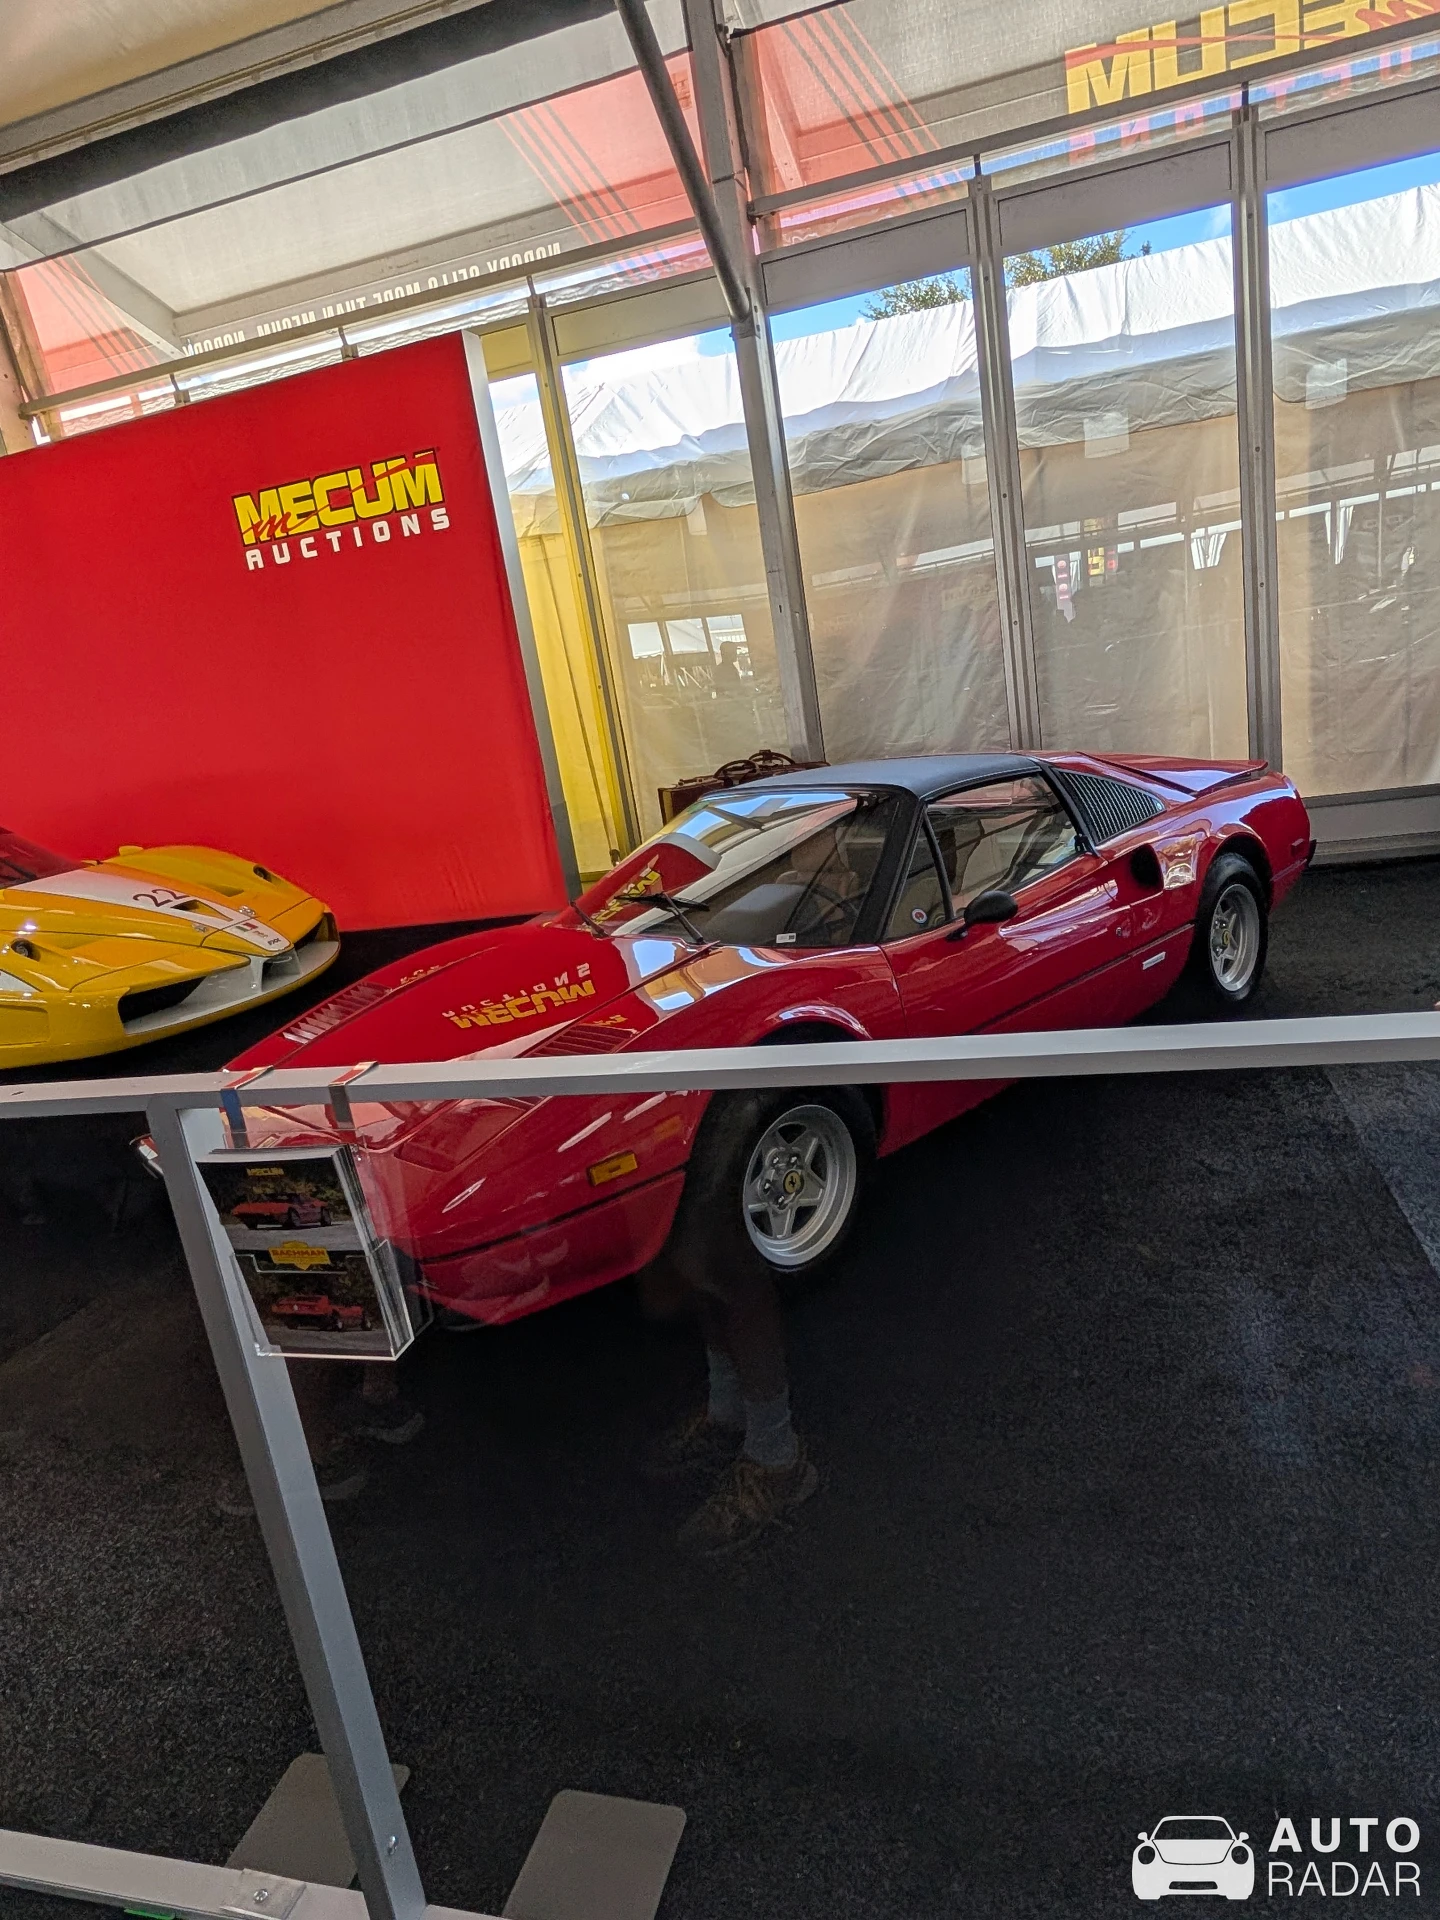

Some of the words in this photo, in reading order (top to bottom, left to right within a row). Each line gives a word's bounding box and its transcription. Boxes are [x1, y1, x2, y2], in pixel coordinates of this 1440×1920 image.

[232, 449, 444, 546] MECUM
[245, 507, 450, 571] AUCTIONS
[133, 889, 190, 907] 22
